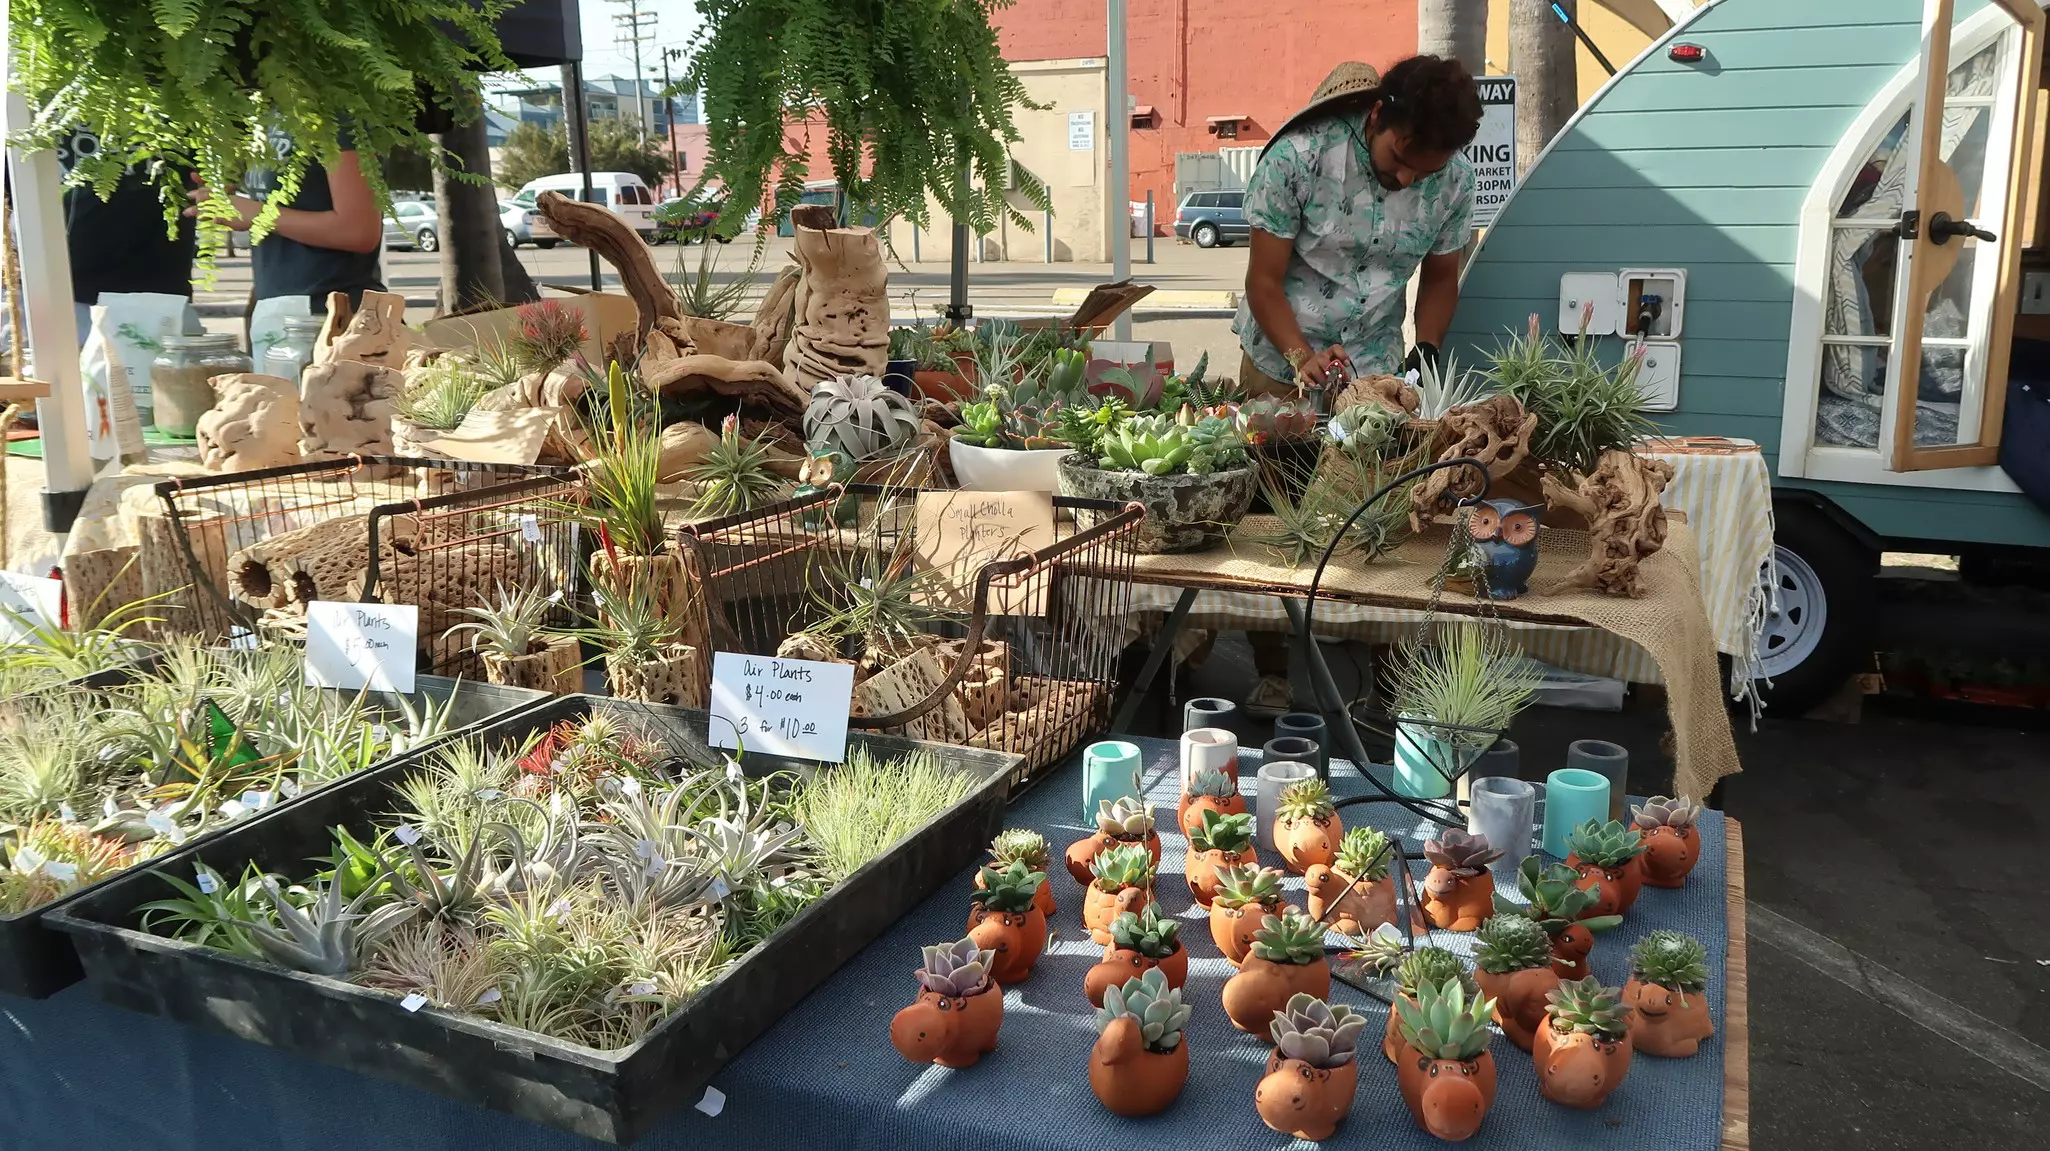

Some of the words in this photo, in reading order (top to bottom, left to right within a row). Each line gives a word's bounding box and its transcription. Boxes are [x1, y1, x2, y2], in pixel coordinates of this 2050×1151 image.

[1479, 83, 1513, 100] WAY
[1476, 194, 1508, 205] RSDA
[946, 503, 976, 522] Small
[980, 500, 1014, 518] Cholla
[356, 610, 391, 630] Plants
[772, 661, 812, 683] Plants
[745, 683, 782, 708] $4.00
[784, 691, 802, 703] each
[738, 716, 749, 735] 3
[759, 719, 773, 733] for
